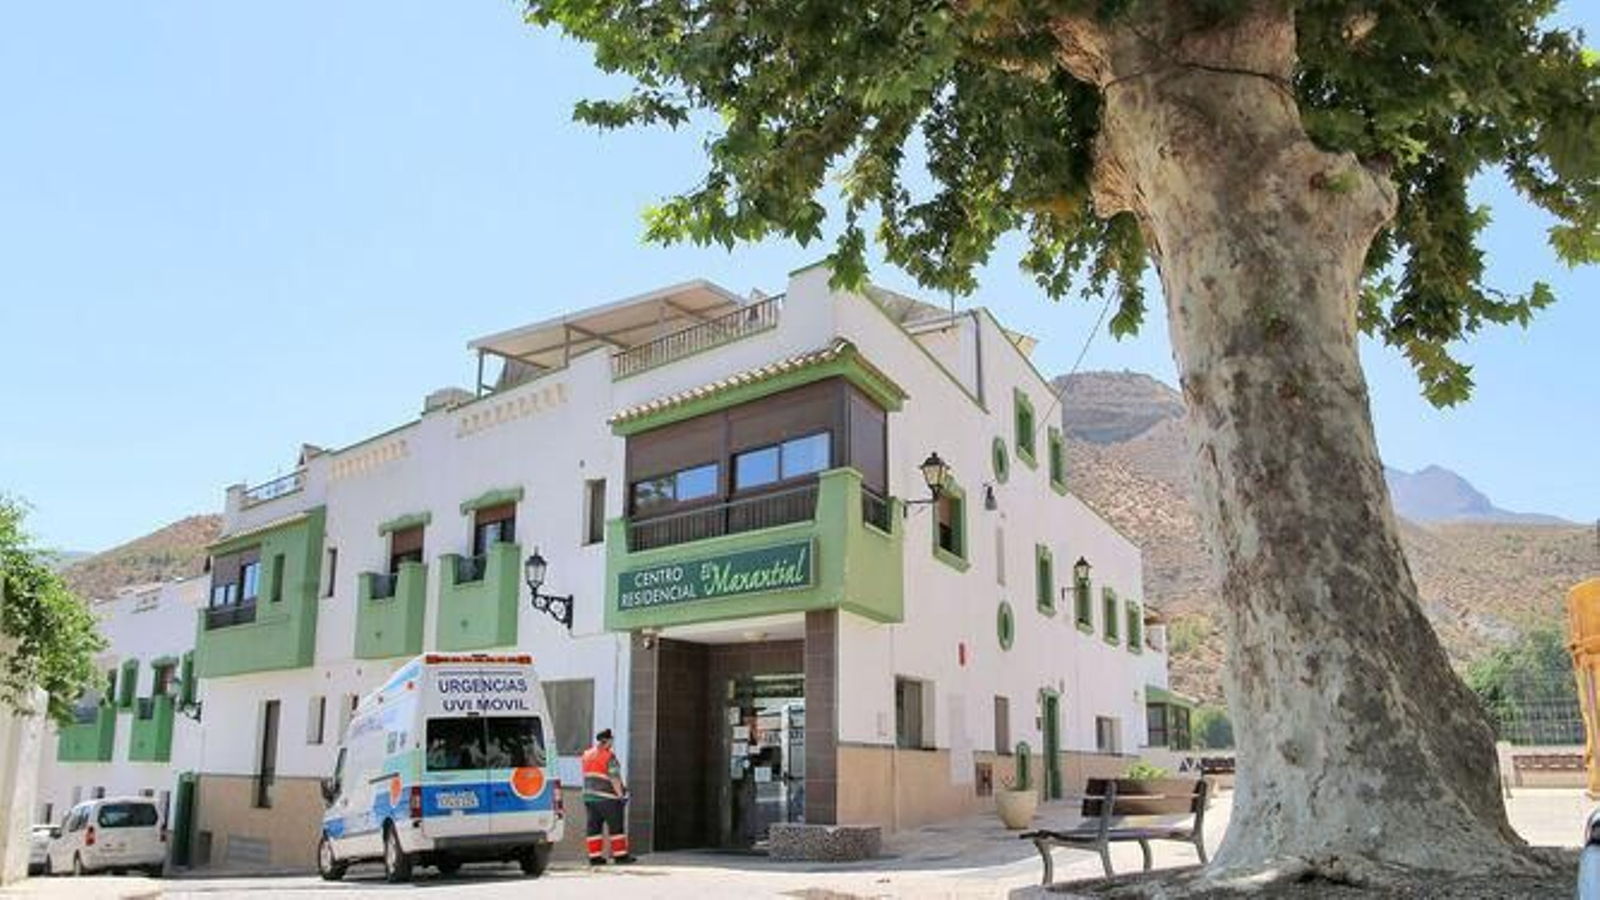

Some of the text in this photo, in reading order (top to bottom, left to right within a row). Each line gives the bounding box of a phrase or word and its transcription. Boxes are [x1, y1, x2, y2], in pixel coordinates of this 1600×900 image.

[634, 566, 683, 588] CENTRO
[621, 582, 696, 607] RESIDENCIAL
[437, 677, 528, 694] URGENCIAS
[442, 698, 473, 712] UVI
